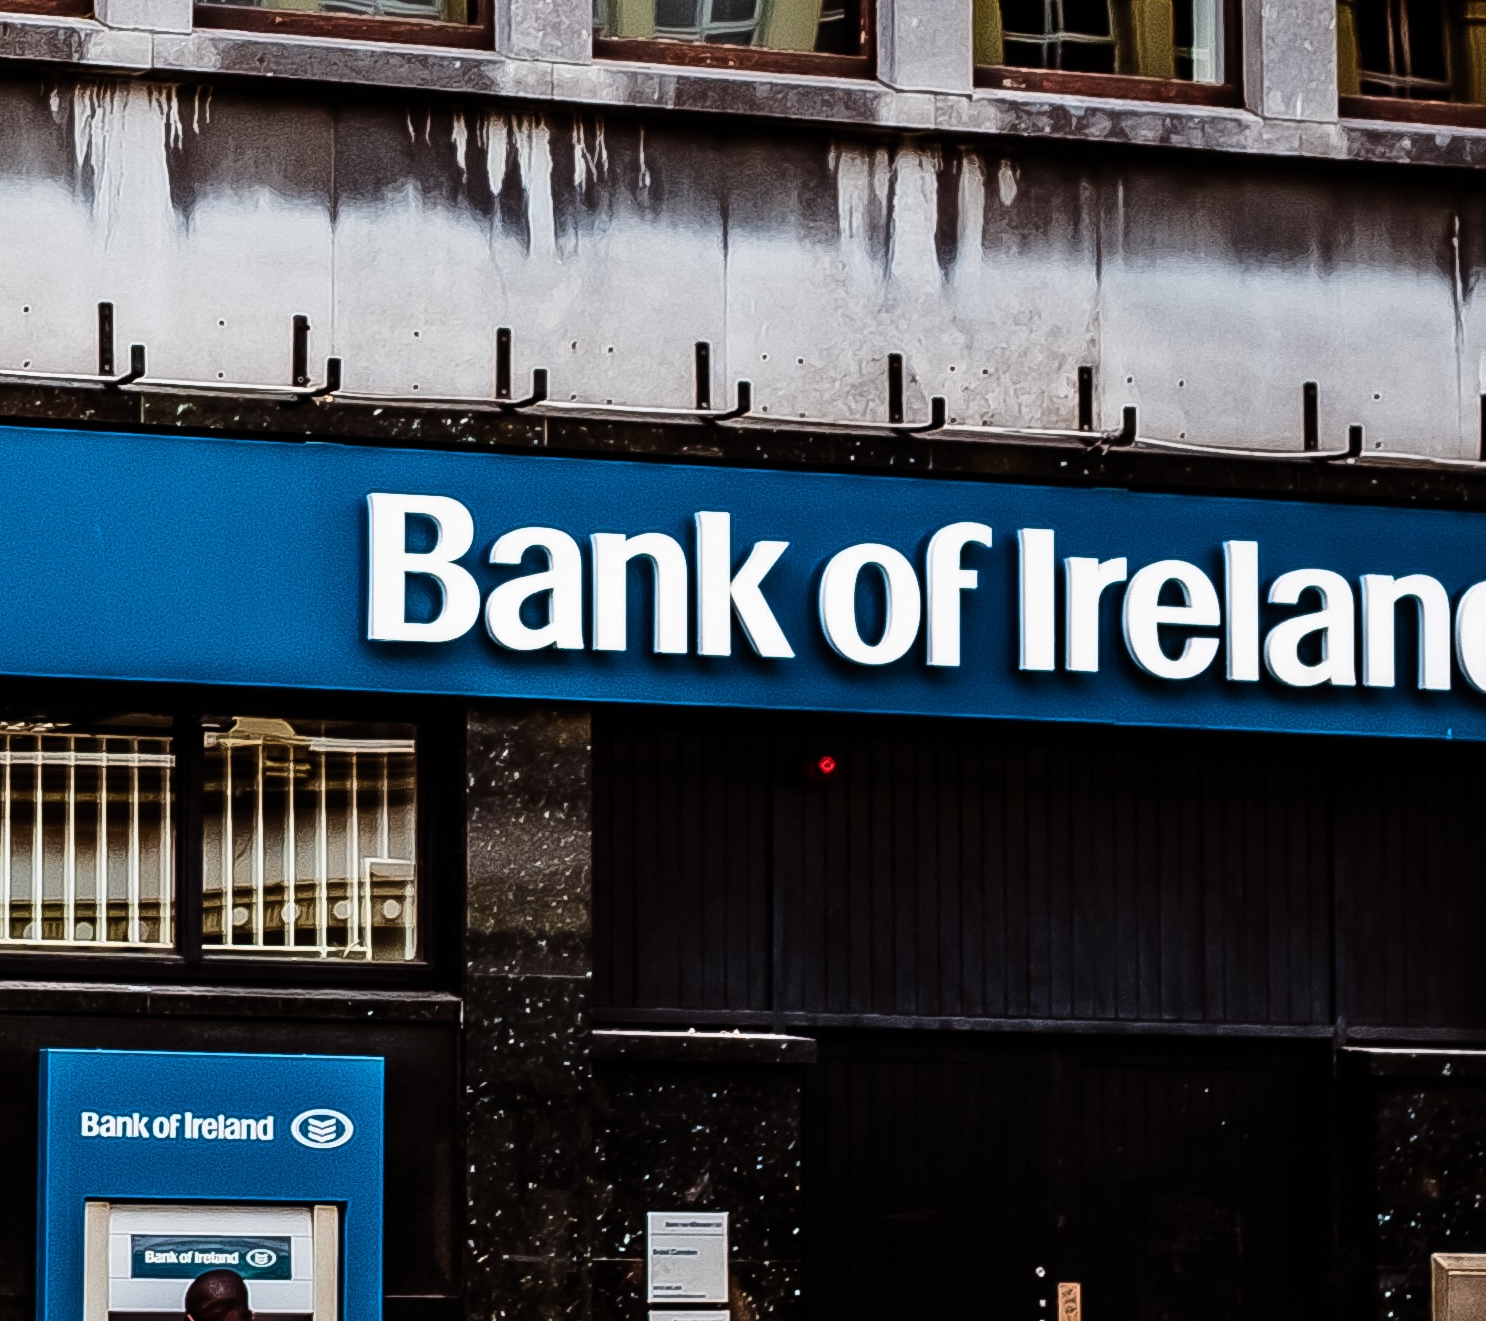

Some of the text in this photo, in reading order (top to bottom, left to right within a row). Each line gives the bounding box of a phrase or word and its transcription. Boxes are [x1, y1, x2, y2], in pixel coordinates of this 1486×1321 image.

[365, 492, 796, 660] Bank
[818, 521, 995, 668] of
[80, 1111, 275, 1141] Bank of Ireland
[144, 1249, 240, 1266] Bank of Ireland
